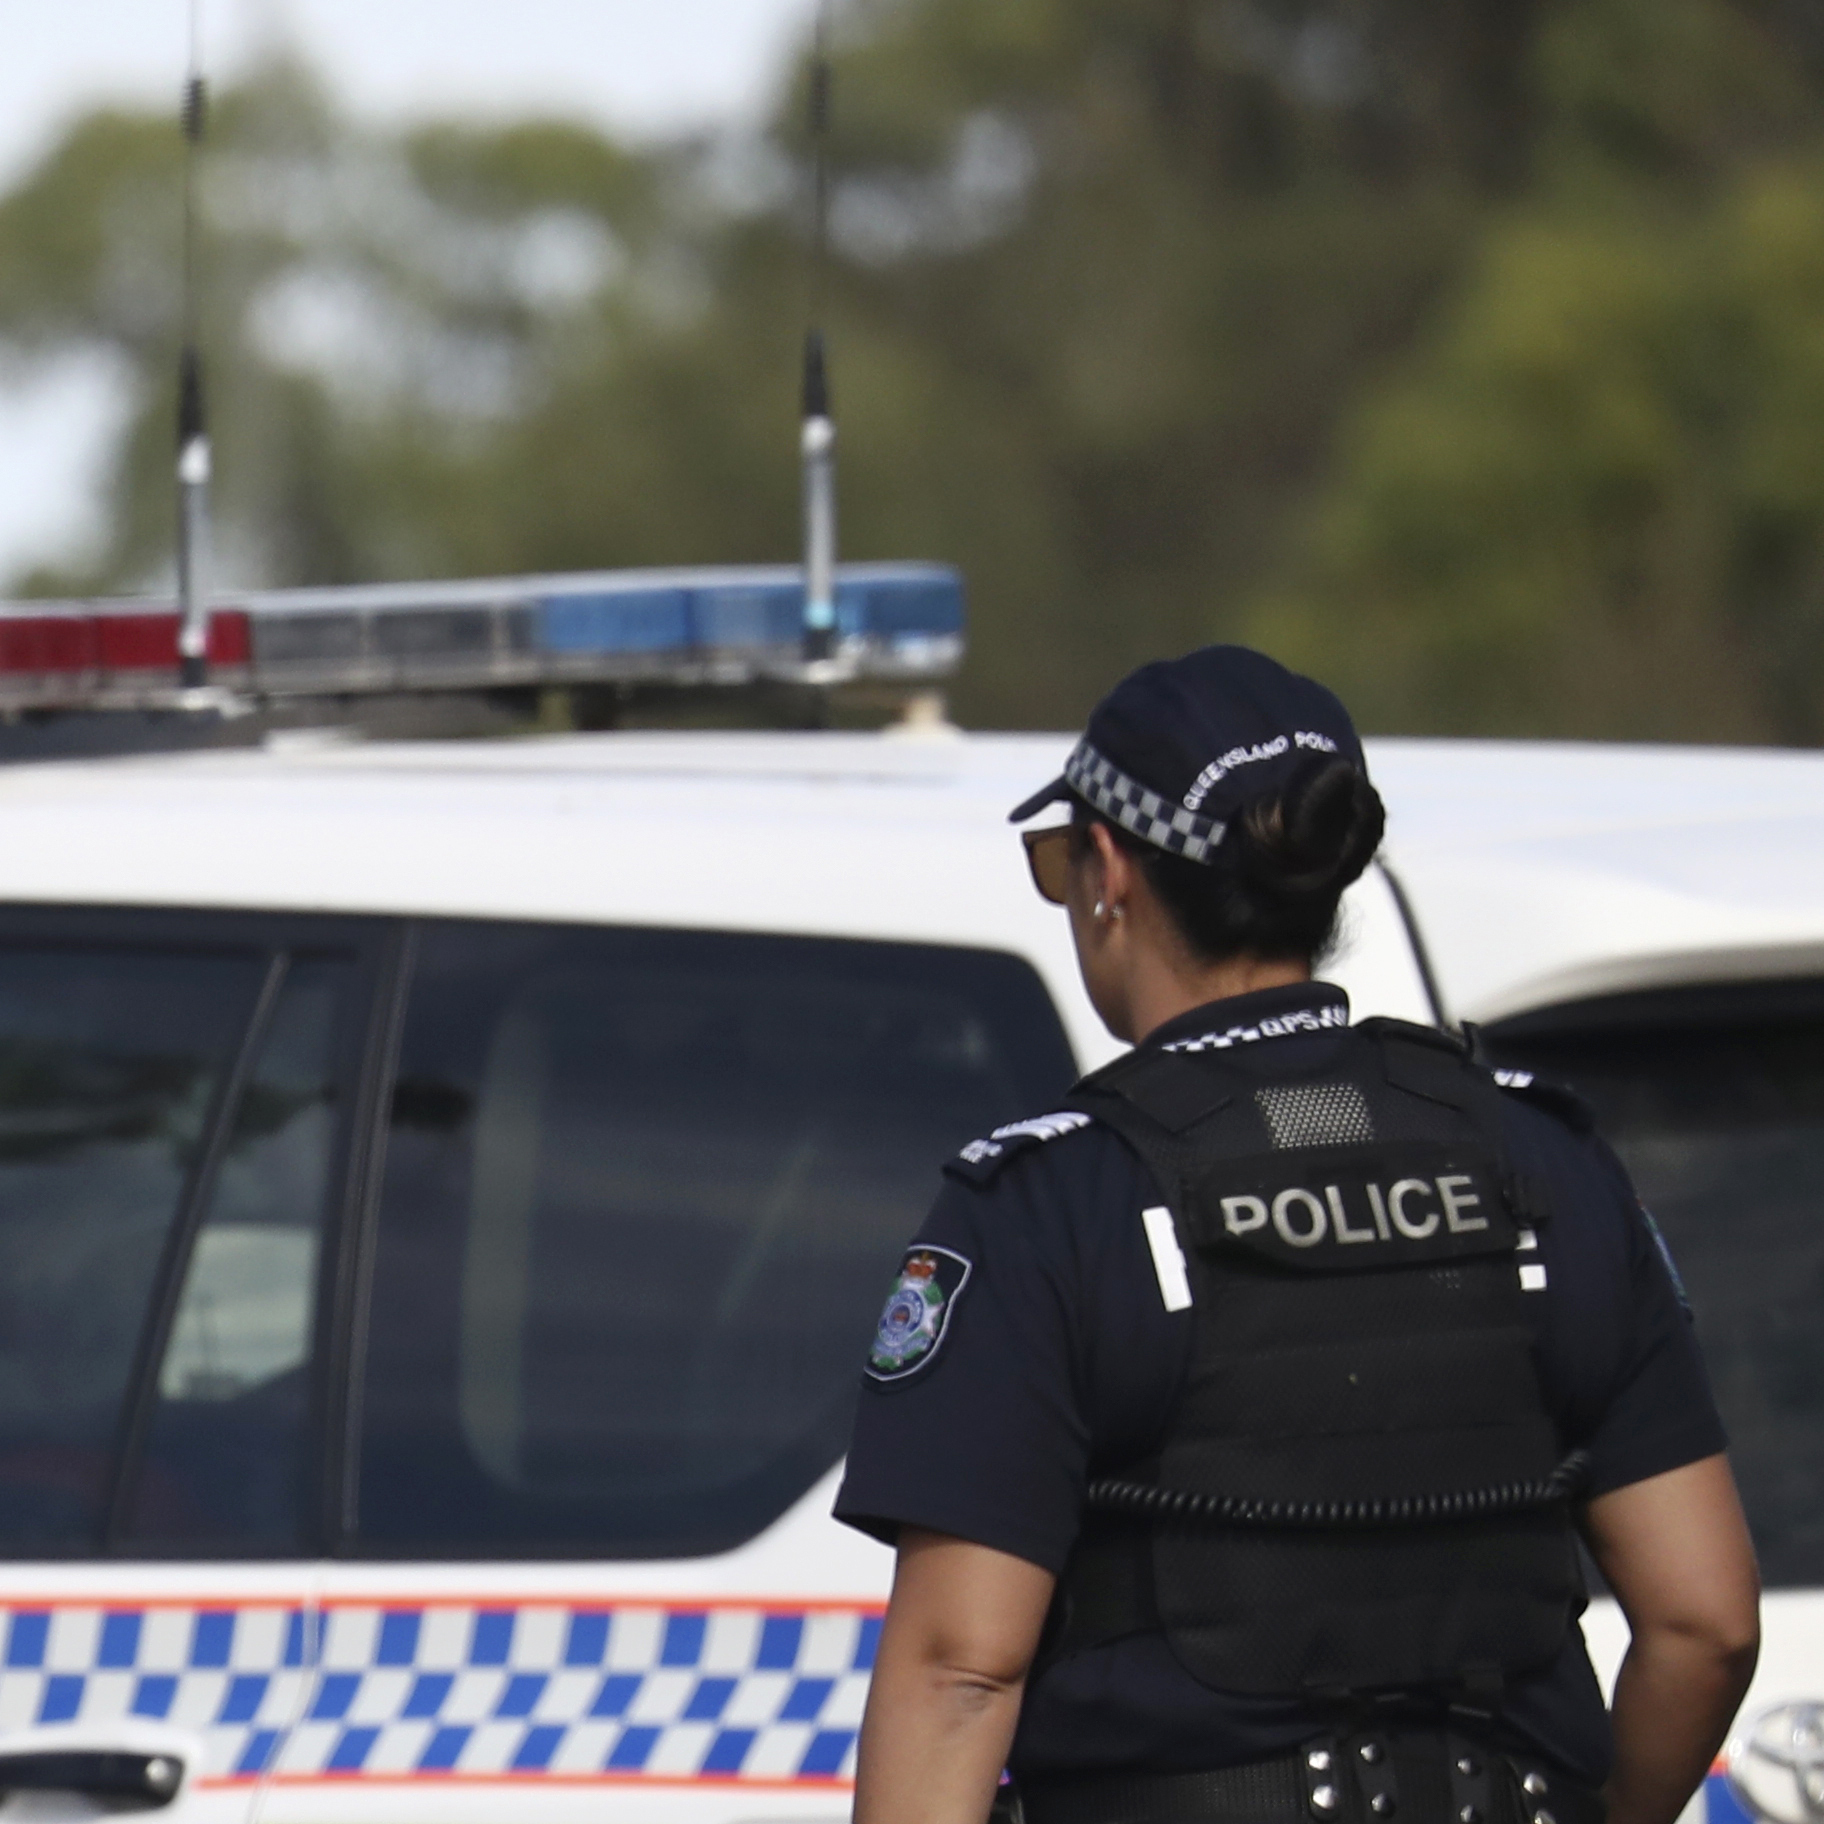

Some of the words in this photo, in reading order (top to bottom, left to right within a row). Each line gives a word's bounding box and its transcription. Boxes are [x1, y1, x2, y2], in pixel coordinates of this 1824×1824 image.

[1182, 735, 1290, 811] QUEENSLAND
[1259, 1010, 1320, 1038] QPS
[1219, 1175, 1489, 1248] POLICE
